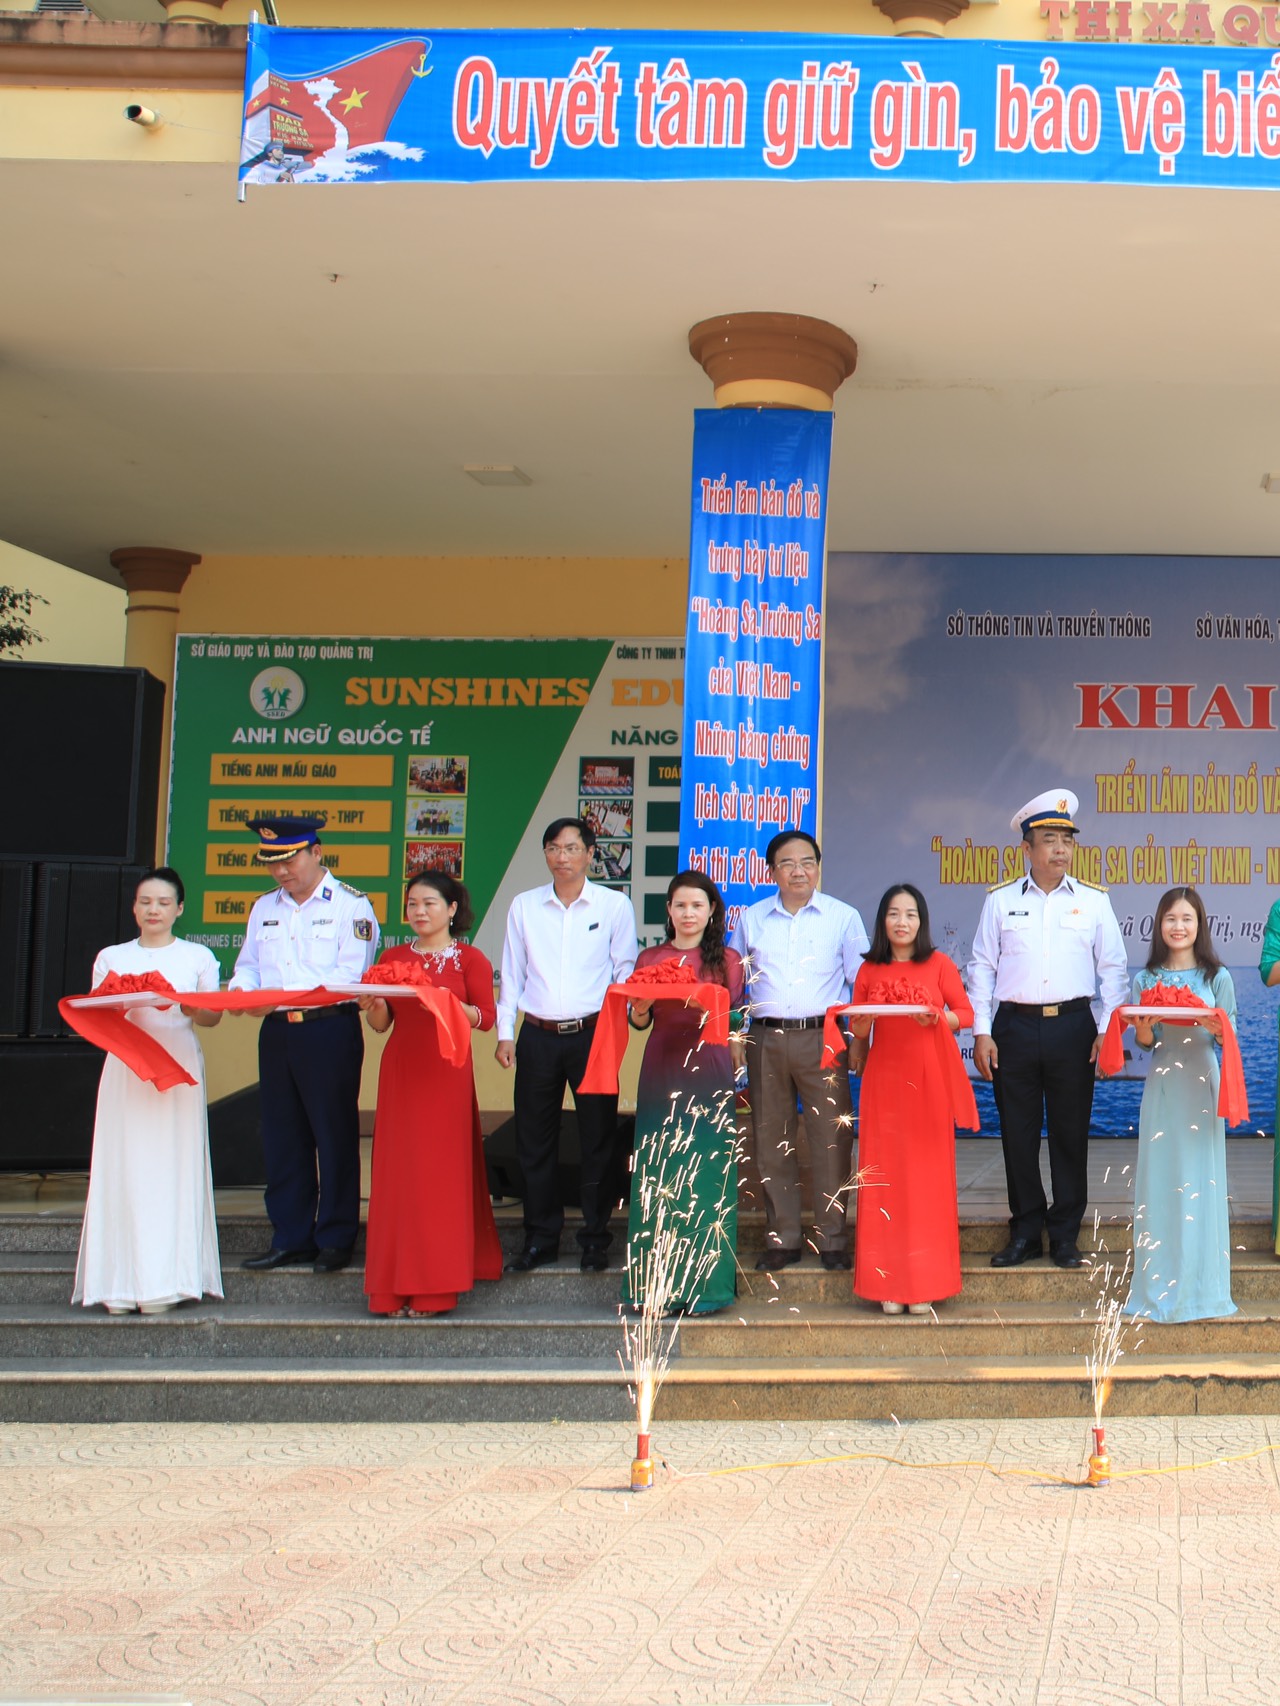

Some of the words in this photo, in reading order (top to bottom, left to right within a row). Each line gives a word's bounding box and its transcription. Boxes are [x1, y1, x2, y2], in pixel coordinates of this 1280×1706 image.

[452, 47, 620, 168] Quyết
[634, 57, 748, 150] tâm
[763, 60, 860, 170] giữ
[869, 60, 976, 169] gìn,
[995, 56, 1101, 153] bảo
[1116, 67, 1186, 175] vệ
[701, 473, 732, 515] Triển
[760, 479, 784, 517] bản
[786, 478, 803, 518] đồ
[805, 483, 820, 519] và
[708, 540, 742, 582] trưng
[744, 539, 766, 584] bày
[768, 543, 783, 577] tư
[785, 542, 809, 586] liệu
[692, 596, 739, 643] “Hoàng
[805, 603, 821, 640] Sa
[947, 609, 965, 637] SỞ
[968, 611, 1009, 637] THÔNG
[1013, 616, 1033, 637] TIN
[1037, 611, 1054, 637] VÀ
[1057, 609, 1105, 638] TRUYỀN
[1109, 611, 1151, 638] THÔNG
[1196, 612, 1213, 639] SỞ
[1216, 614, 1241, 639] VĂN
[1245, 613, 1274, 643] HÓA,
[191, 640, 205, 657] SỞ
[208, 642, 230, 657] GIÁO
[234, 644, 253, 660] DỤC
[258, 642, 270, 658] VÀ
[274, 643, 294, 658] ĐÀO
[298, 645, 316, 660] TẠO
[320, 642, 354, 660] QUẢNG
[358, 646, 374, 661] TRỊ
[642, 647, 651, 660] TY
[655, 647, 676, 660] TNHH
[345, 677, 590, 706] SUNSHINES
[708, 655, 733, 695] của
[735, 661, 760, 705] Việt
[762, 663, 791, 699] Nam
[1074, 682, 1278, 731] KHAI
[232, 728, 276, 744] ANH
[284, 723, 331, 744] NGỮ
[338, 720, 404, 745] QUỐC
[410, 720, 434, 745] TẾ
[611, 725, 679, 746] NĂNG
[694, 720, 735, 766] Những
[738, 717, 769, 768] bằng
[771, 725, 810, 770] chứng
[221, 759, 252, 777] TIẾNG
[255, 764, 278, 777] ANH
[312, 762, 337, 778] GIÁO
[1095, 758, 1147, 814] TRIỂN
[1151, 766, 1188, 814] LÃM
[1192, 762, 1232, 814] BẢN
[1234, 760, 1259, 815] ĐỒ
[219, 805, 249, 822] TIẾNG
[338, 810, 364, 823] THPT
[694, 783, 719, 828] lịch
[721, 781, 738, 820] sử
[740, 785, 755, 823] và
[757, 786, 788, 831] pháp
[217, 850, 247, 867] TIẾNG
[710, 847, 728, 892] thị
[730, 848, 746, 884] xã
[931, 836, 998, 885] “HOÀNG
[1106, 846, 1128, 885] SA
[1132, 834, 1168, 885] CỦA
[1170, 838, 1207, 890] VIỆT
[1211, 846, 1250, 885] NAM
[215, 897, 245, 914] TIẾNG
